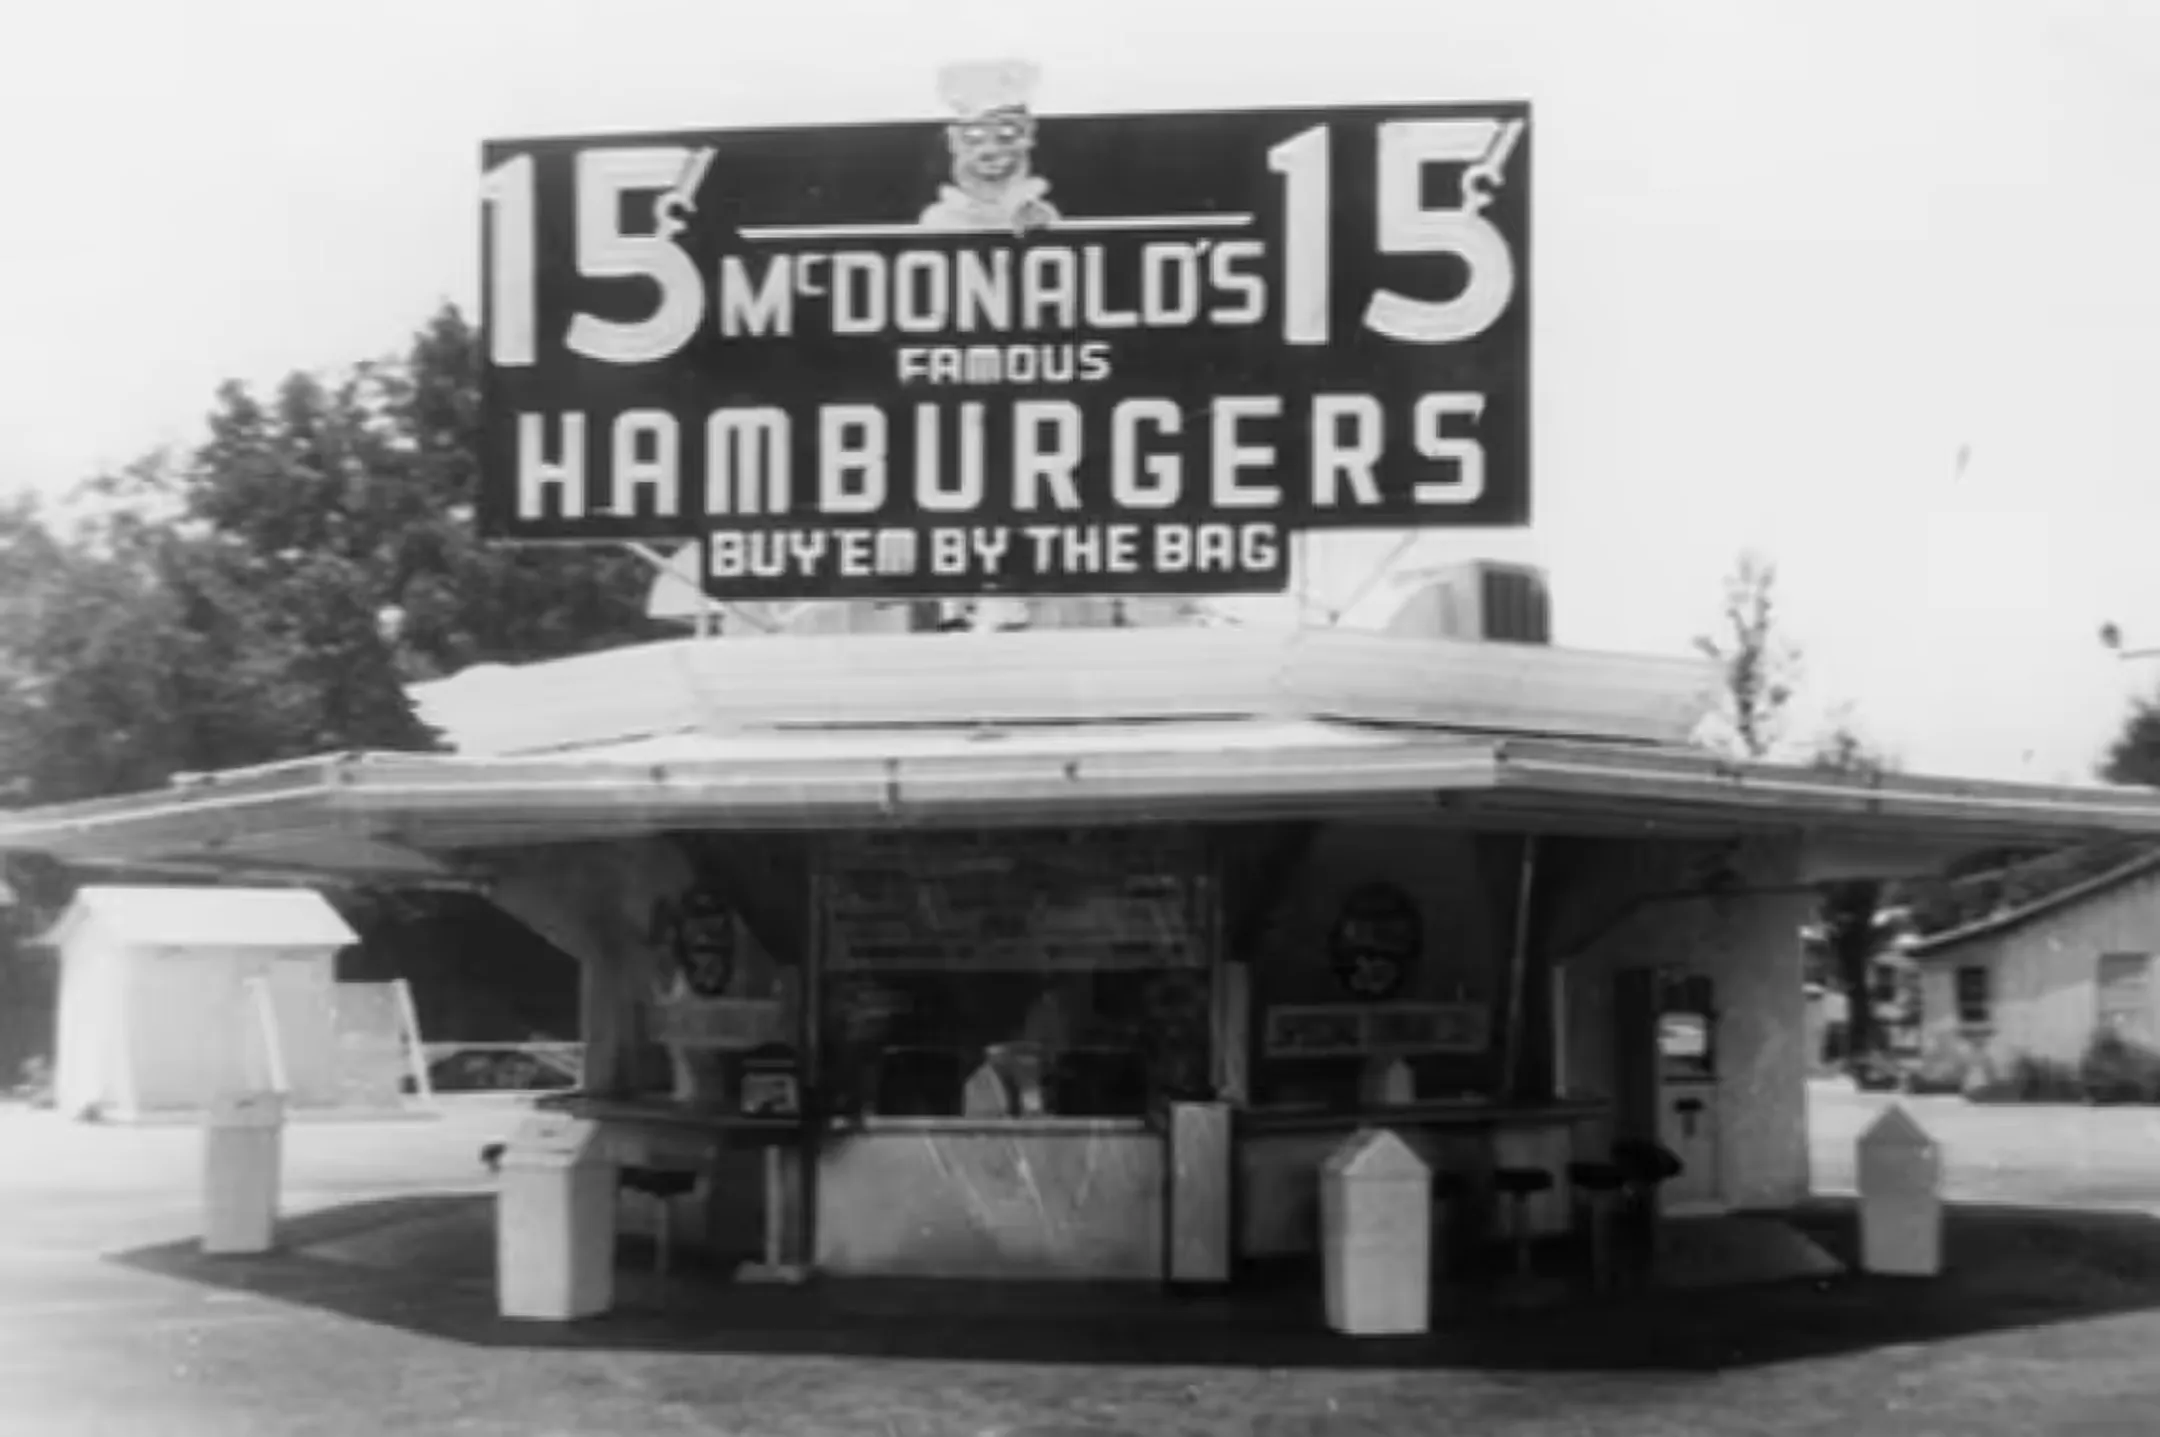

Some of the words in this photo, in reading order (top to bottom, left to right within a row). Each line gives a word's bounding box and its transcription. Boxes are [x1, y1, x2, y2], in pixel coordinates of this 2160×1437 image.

[897, 343, 1111, 383] FAMOUS
[517, 392, 1486, 518] HAMBURGERS
[931, 527, 1009, 575] BY
[1023, 524, 1139, 573] THE
[1155, 523, 1278, 572] BAG
